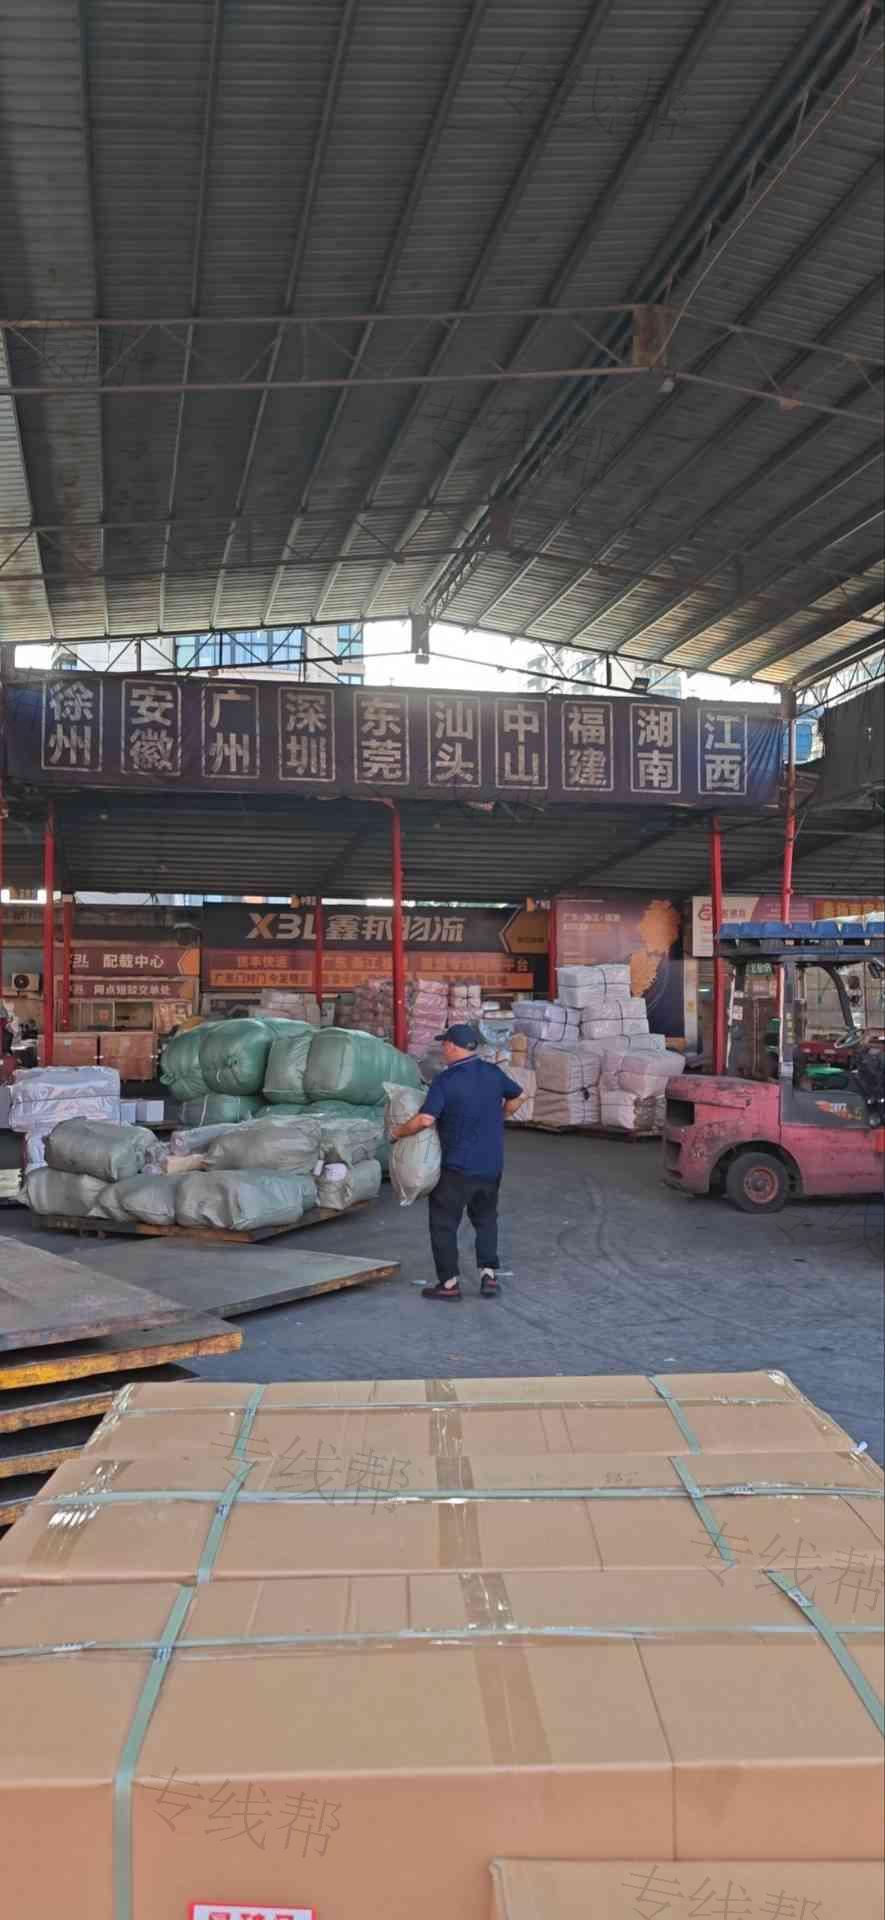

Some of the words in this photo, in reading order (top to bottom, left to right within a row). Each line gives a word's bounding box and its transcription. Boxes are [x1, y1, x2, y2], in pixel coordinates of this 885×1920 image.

[48, 681, 95, 766] 徐州
[128, 686, 173, 771] 安徽
[209, 688, 251, 774] 广州
[286, 694, 327, 776] 深圳
[361, 698, 403, 780] 东莞
[434, 702, 474, 782] 汕头
[503, 704, 540, 785] 中山
[568, 706, 607, 787] 福建
[637, 710, 674, 789] 湖南
[703, 714, 742, 791] 江西
[103, 953, 165, 969] 配载中心
[325, 914, 465, 943] 鑫邦物流
